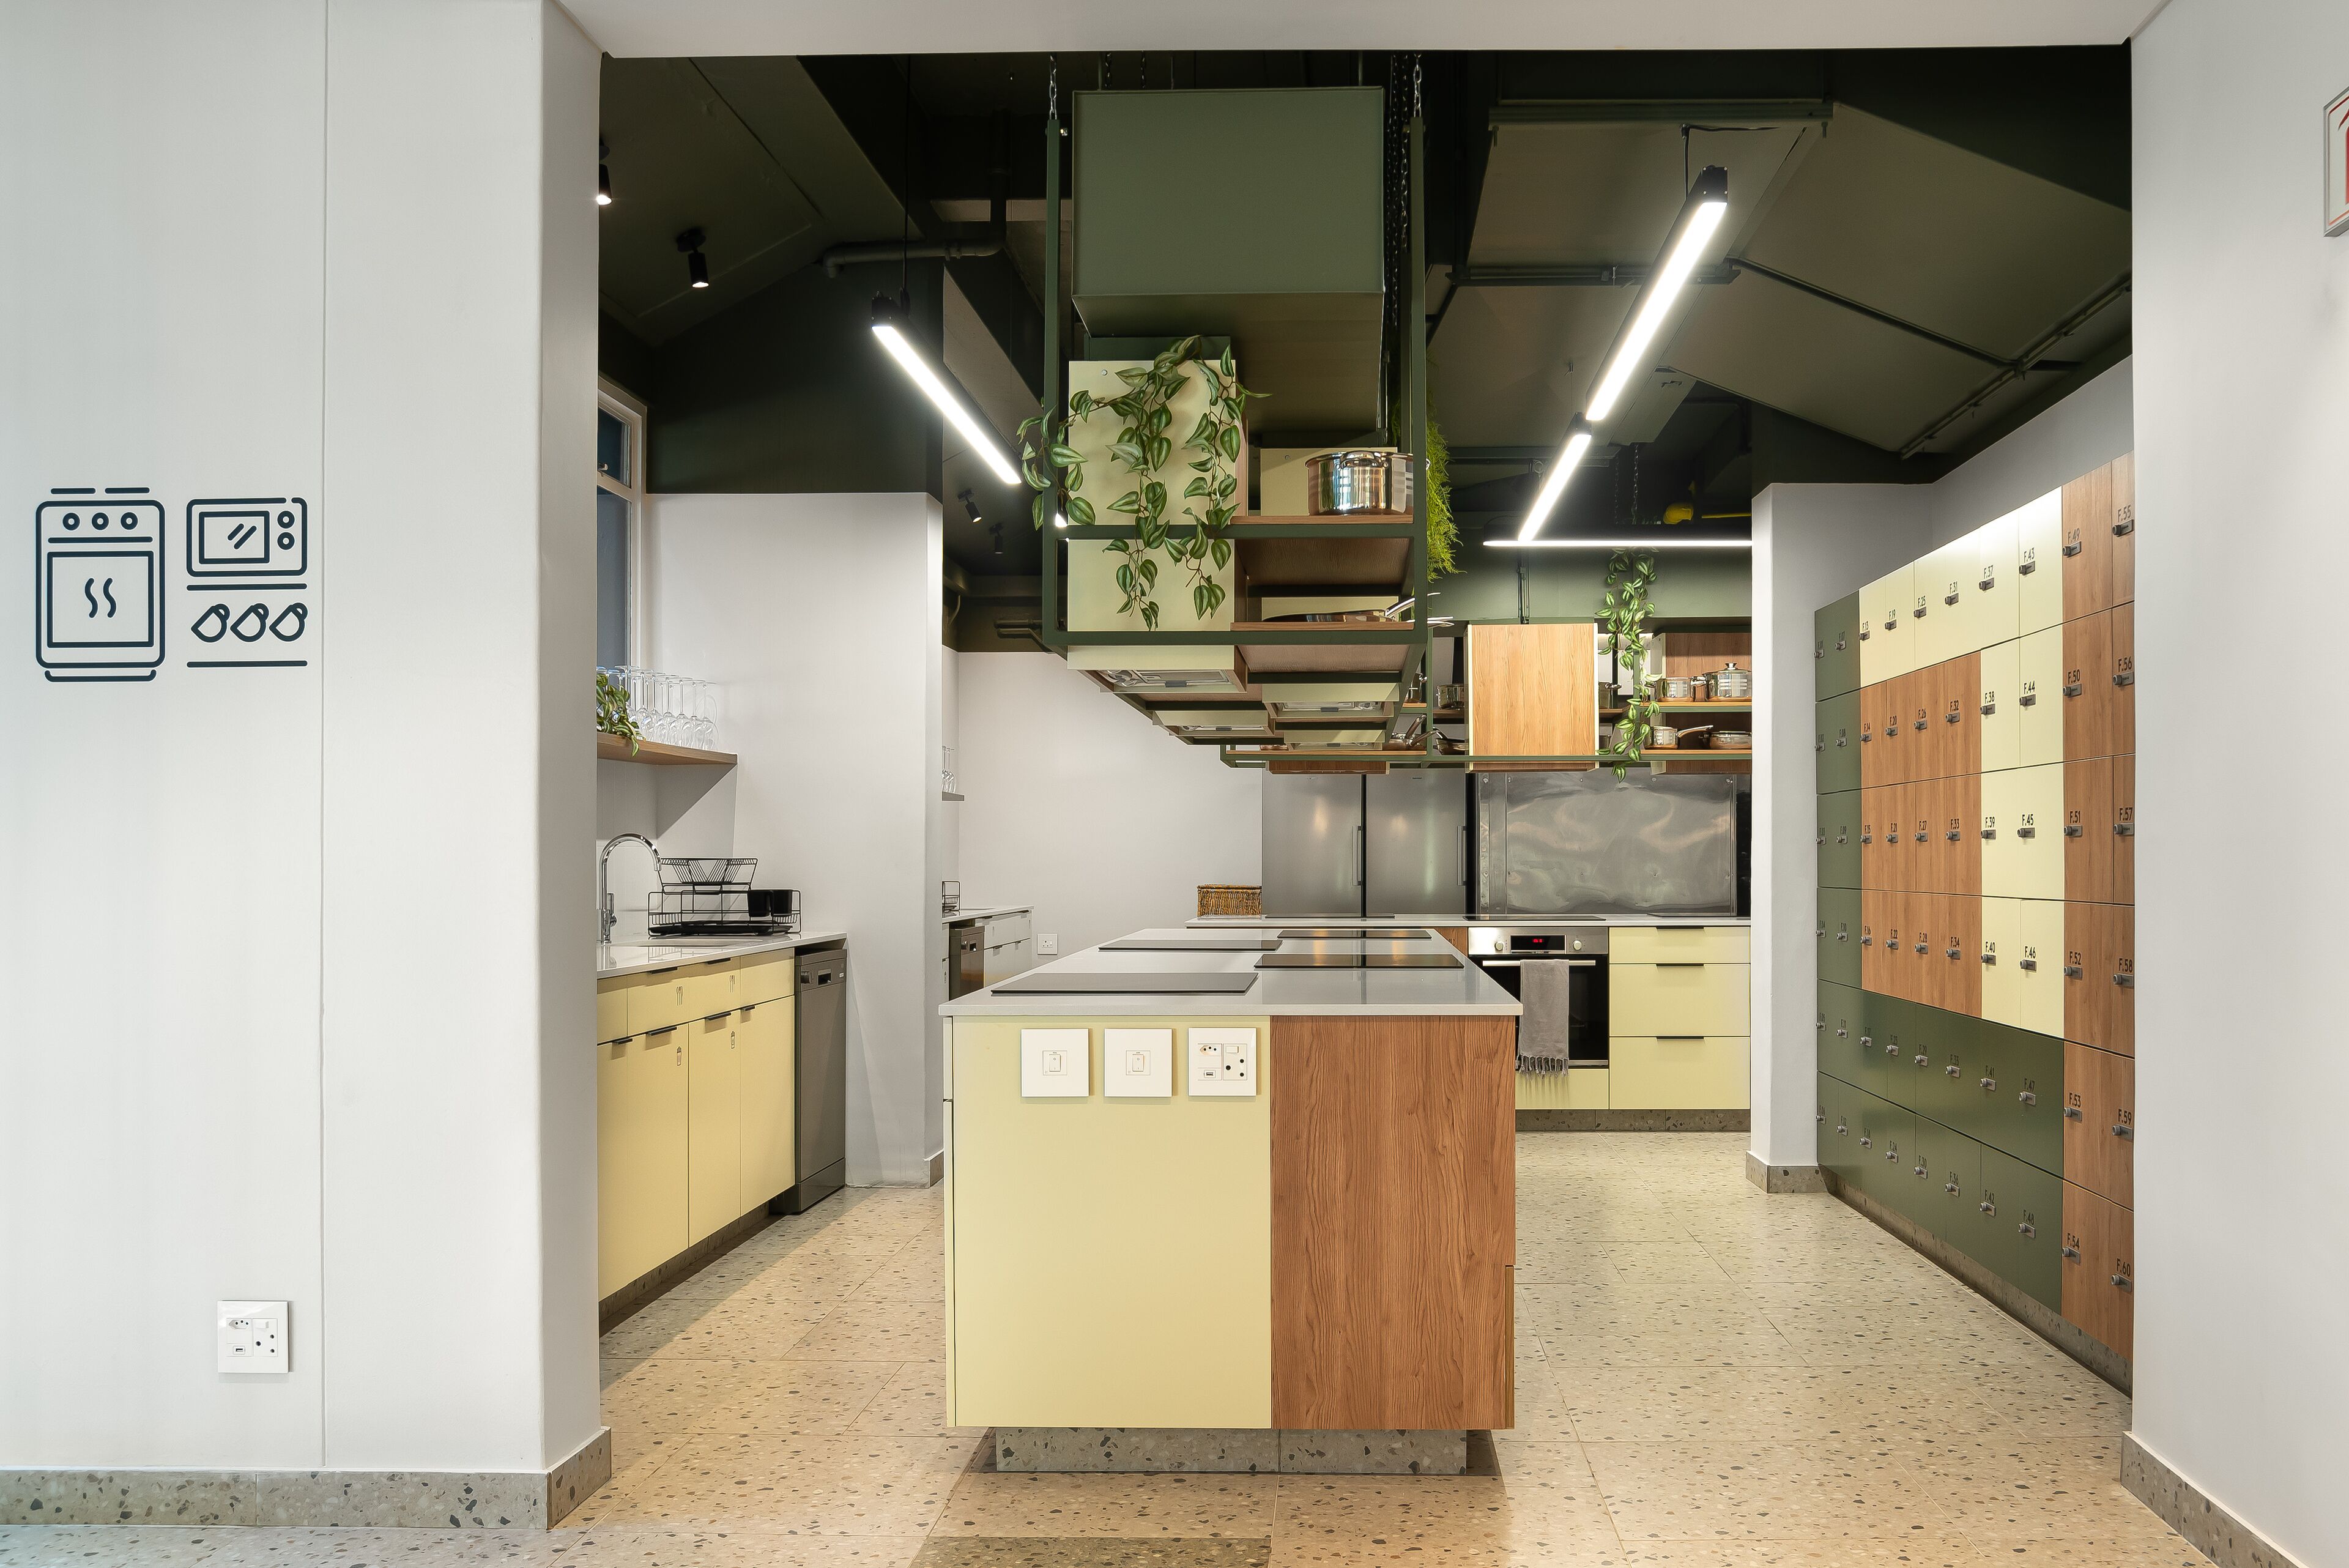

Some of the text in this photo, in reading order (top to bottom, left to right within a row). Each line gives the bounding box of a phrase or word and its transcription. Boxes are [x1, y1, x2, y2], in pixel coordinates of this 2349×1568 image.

[2118, 505, 2131, 522] F.55
[2068, 528, 2080, 544] F.49
[2024, 548, 2035, 563] F.43
[1984, 565, 1994, 579] F.37
[2118, 656, 2132, 672] F.56
[2068, 669, 2080, 684] F.50
[2024, 680, 2035, 694] F.44
[1984, 691, 1994, 704] F.38
[1950, 700, 1959, 712] F.32
[2022, 814, 2033, 826] F.45
[2069, 811, 2080, 823] F.51
[2120, 808, 2133, 821] F.57
[1951, 819, 1959, 830] F.33
[1985, 816, 1995, 828] F.39
[1951, 937, 1960, 948] F.34
[1986, 942, 1995, 953] F.40
[2025, 946, 2036, 959] F.46
[2069, 951, 2081, 965] F.52
[2119, 958, 2132, 973] F.58
[1985, 1065, 1994, 1078] F.41
[2024, 1078, 2035, 1092] F.47
[2069, 1092, 2081, 1108] F.53
[2118, 1109, 2132, 1125] F.59
[1950, 1171, 1959, 1185] F.36
[1984, 1189, 1995, 1204] F.42
[2023, 1209, 2035, 1225] F.48
[2067, 1233, 2080, 1250] F.54
[2117, 1258, 2131, 1277] F.60
